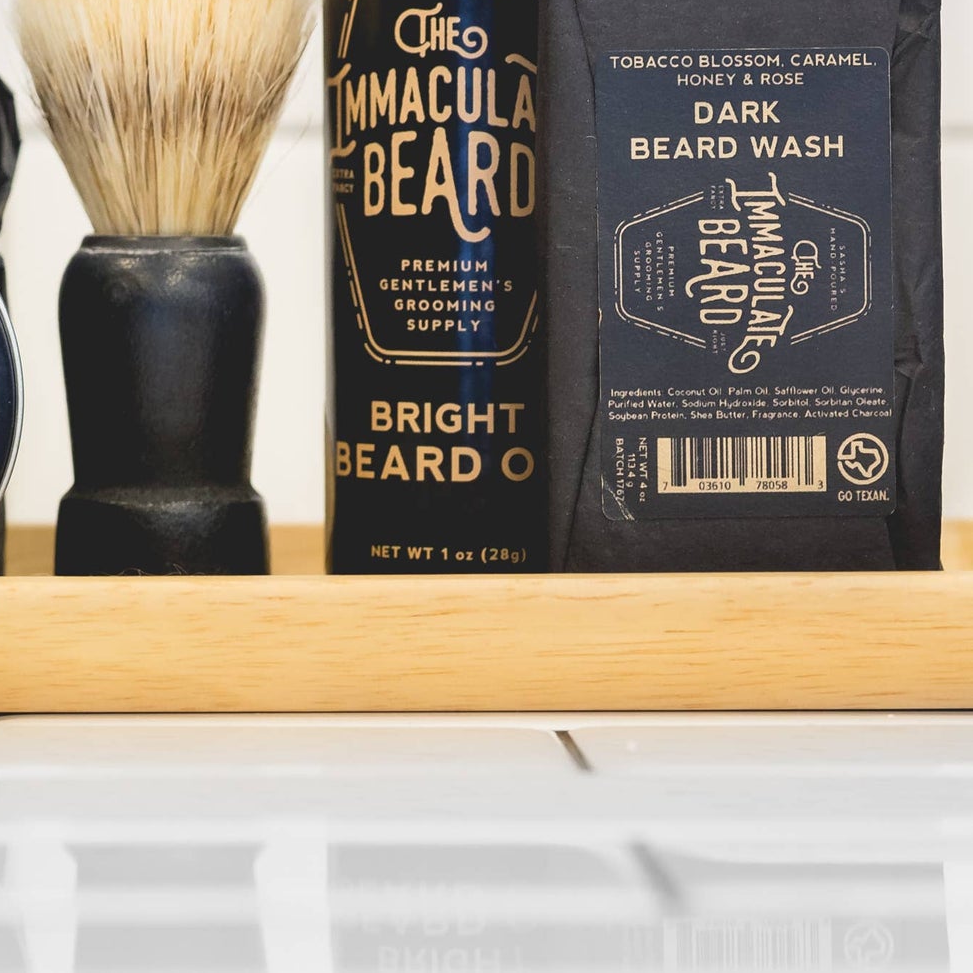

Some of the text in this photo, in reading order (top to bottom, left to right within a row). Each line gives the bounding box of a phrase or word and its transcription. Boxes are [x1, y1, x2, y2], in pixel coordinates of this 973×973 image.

[393, 2, 489, 59] THE
[609, 56, 693, 70] TOBACCO
[677, 73, 804, 87] HONEY & ROSE
[327, 53, 538, 158] IMMACULA
[694, 100, 781, 125] DARK
[630, 135, 844, 160] BEARD WASH
[363, 126, 535, 243] BEARD
[401, 259, 489, 273] PREMIUM
[633, 250, 642, 294] SUPPLY
[667, 245, 675, 298] PREMIUM
[685, 219, 751, 326] BEARD
[725, 171, 794, 374] IMMACULATE
[379, 279, 514, 293] GENTLEMEN'S
[394, 298, 496, 313] GROOMING
[406, 319, 481, 332] SUPPLY
[667, 387, 706, 397] Coconut
[728, 386, 753, 396] Palm
[774, 386, 818, 395] Safflower
[608, 399, 645, 409] Purified
[682, 398, 716, 408] Sodium
[815, 397, 853, 407] Sorbitan
[370, 400, 525, 435] BRIGHT
[608, 411, 648, 422] Soybean
[690, 410, 713, 419] Shea
[804, 409, 849, 419] Activated
[851, 408, 893, 418] Charcoal
[615, 437, 625, 476] BATCH
[638, 437, 648, 459] NET
[335, 441, 483, 483] BEARD
[639, 462, 648, 479] WT
[662, 480, 824, 491] 7 03610 78058 3
[838, 490, 853, 502] GO
[371, 545, 527, 564] NET WT 1 oz (28g)
